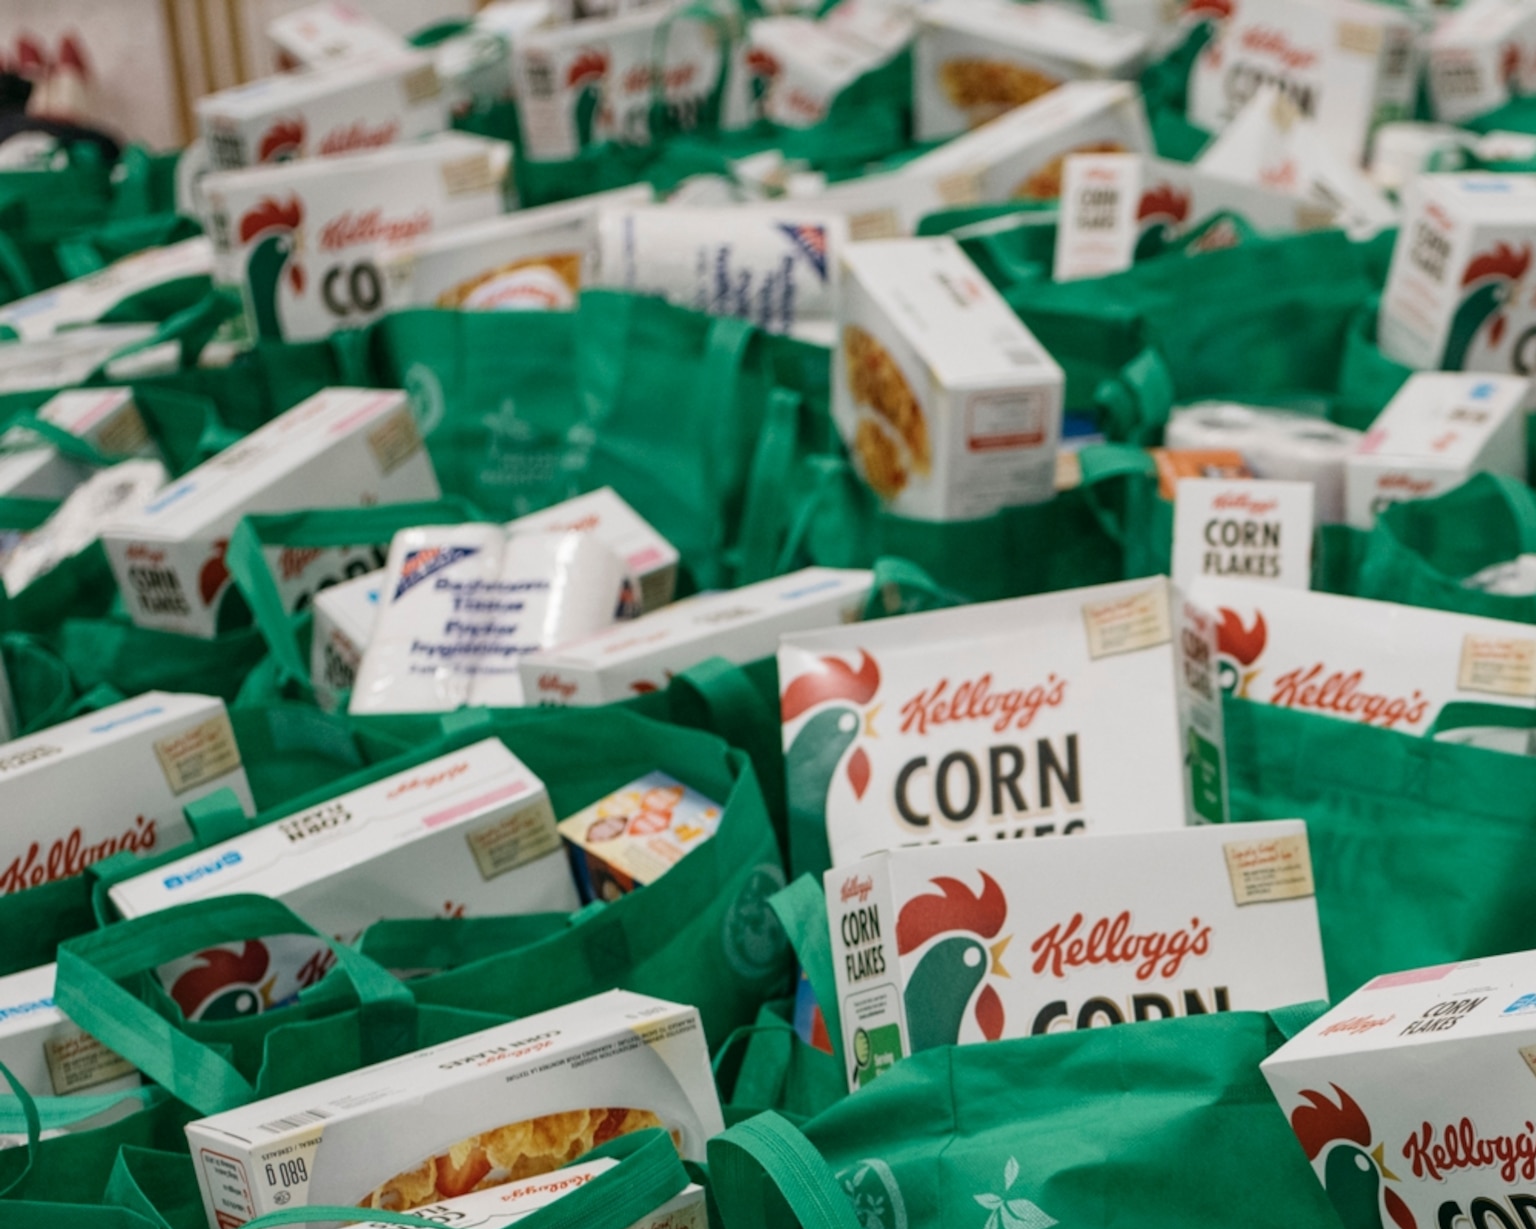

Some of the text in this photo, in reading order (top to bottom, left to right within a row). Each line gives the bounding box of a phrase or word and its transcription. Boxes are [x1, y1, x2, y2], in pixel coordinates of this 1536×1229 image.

[318, 208, 434, 252] Kellogg's
[321, 261, 382, 317] CO
[1203, 518, 1281, 550] CORN
[1203, 551, 1281, 579] FLAKES
[898, 672, 1069, 734] Kellogg's
[1271, 665, 1427, 727] Kellogg's
[893, 733, 1082, 827] CORN
[841, 904, 881, 947] CORN
[845, 945, 886, 982] FLAKES
[1030, 911, 1212, 981] Kellogg's
[1318, 1014, 1396, 1038] Kellogg's
[1399, 1015, 1467, 1038] FLAKES
[1422, 997, 1488, 1019] CORN
[279, 1157, 309, 1188] 680
[496, 1167, 596, 1205] Kellogg's
